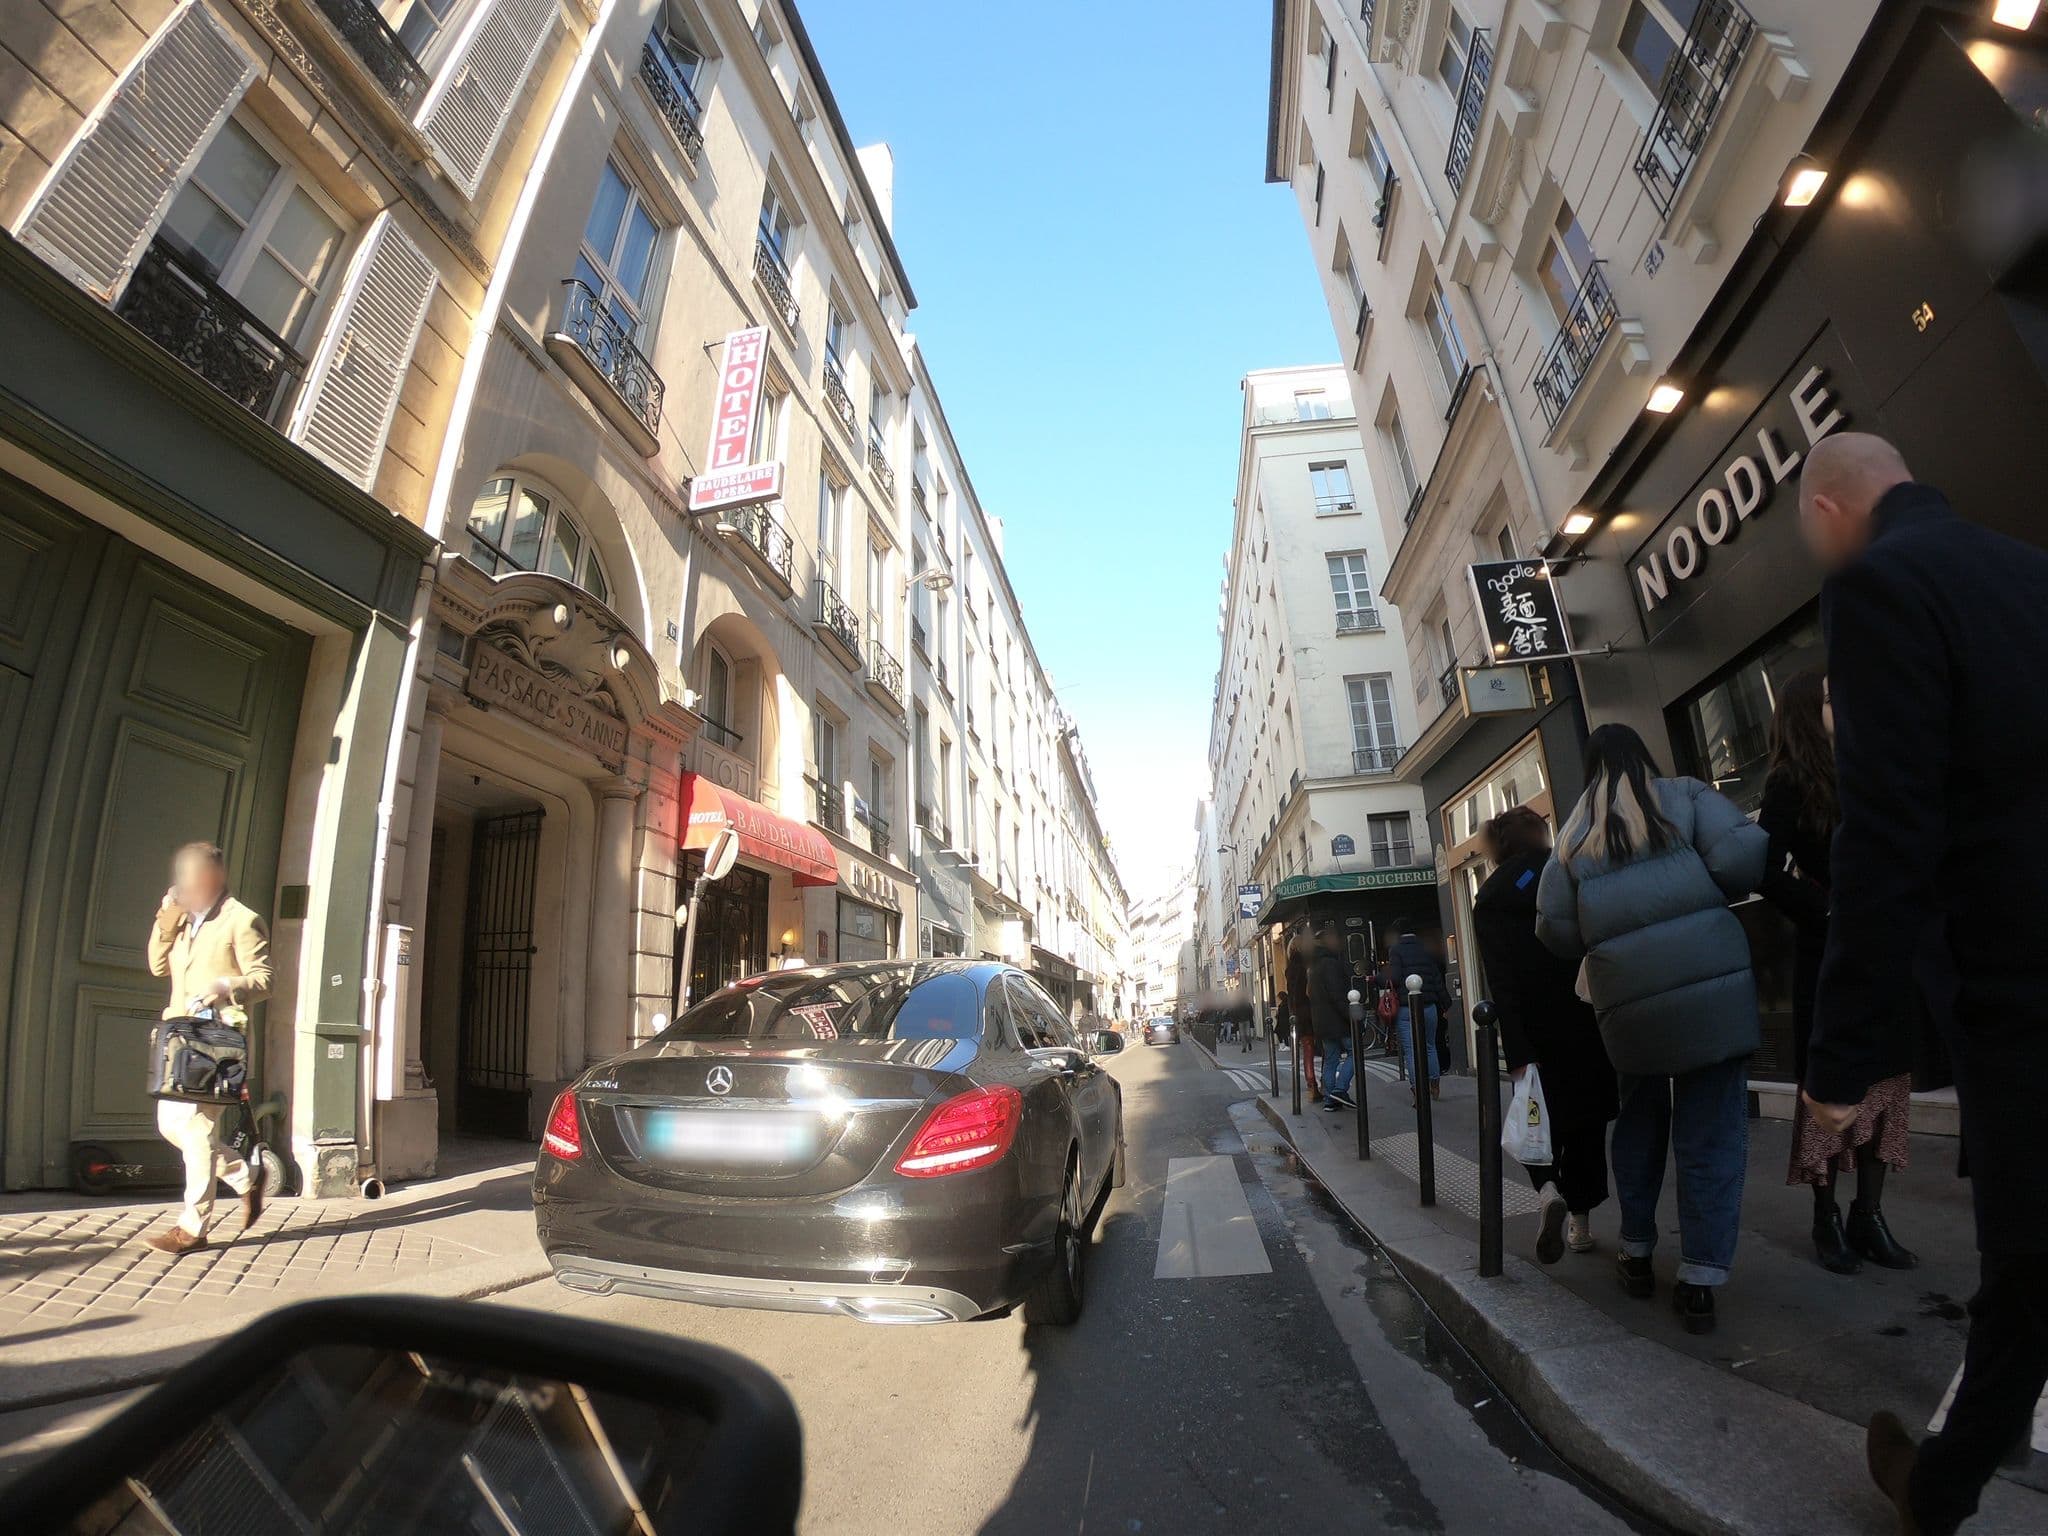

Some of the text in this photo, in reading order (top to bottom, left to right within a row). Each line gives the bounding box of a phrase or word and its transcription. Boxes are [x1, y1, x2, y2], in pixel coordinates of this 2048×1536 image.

[1911, 301, 1934, 332] 54
[714, 341, 760, 467] HOTEL
[698, 467, 773, 492] BAUDELAIRE
[713, 482, 753, 499] OPERA
[1637, 365, 1845, 612] NOODLE
[473, 655, 559, 719] PASSAGE
[581, 716, 624, 752] ANNE
[688, 811, 723, 824] HOTEL
[736, 809, 827, 860] BAUDELAIRE
[1357, 870, 1436, 886] BOUCHERIE
